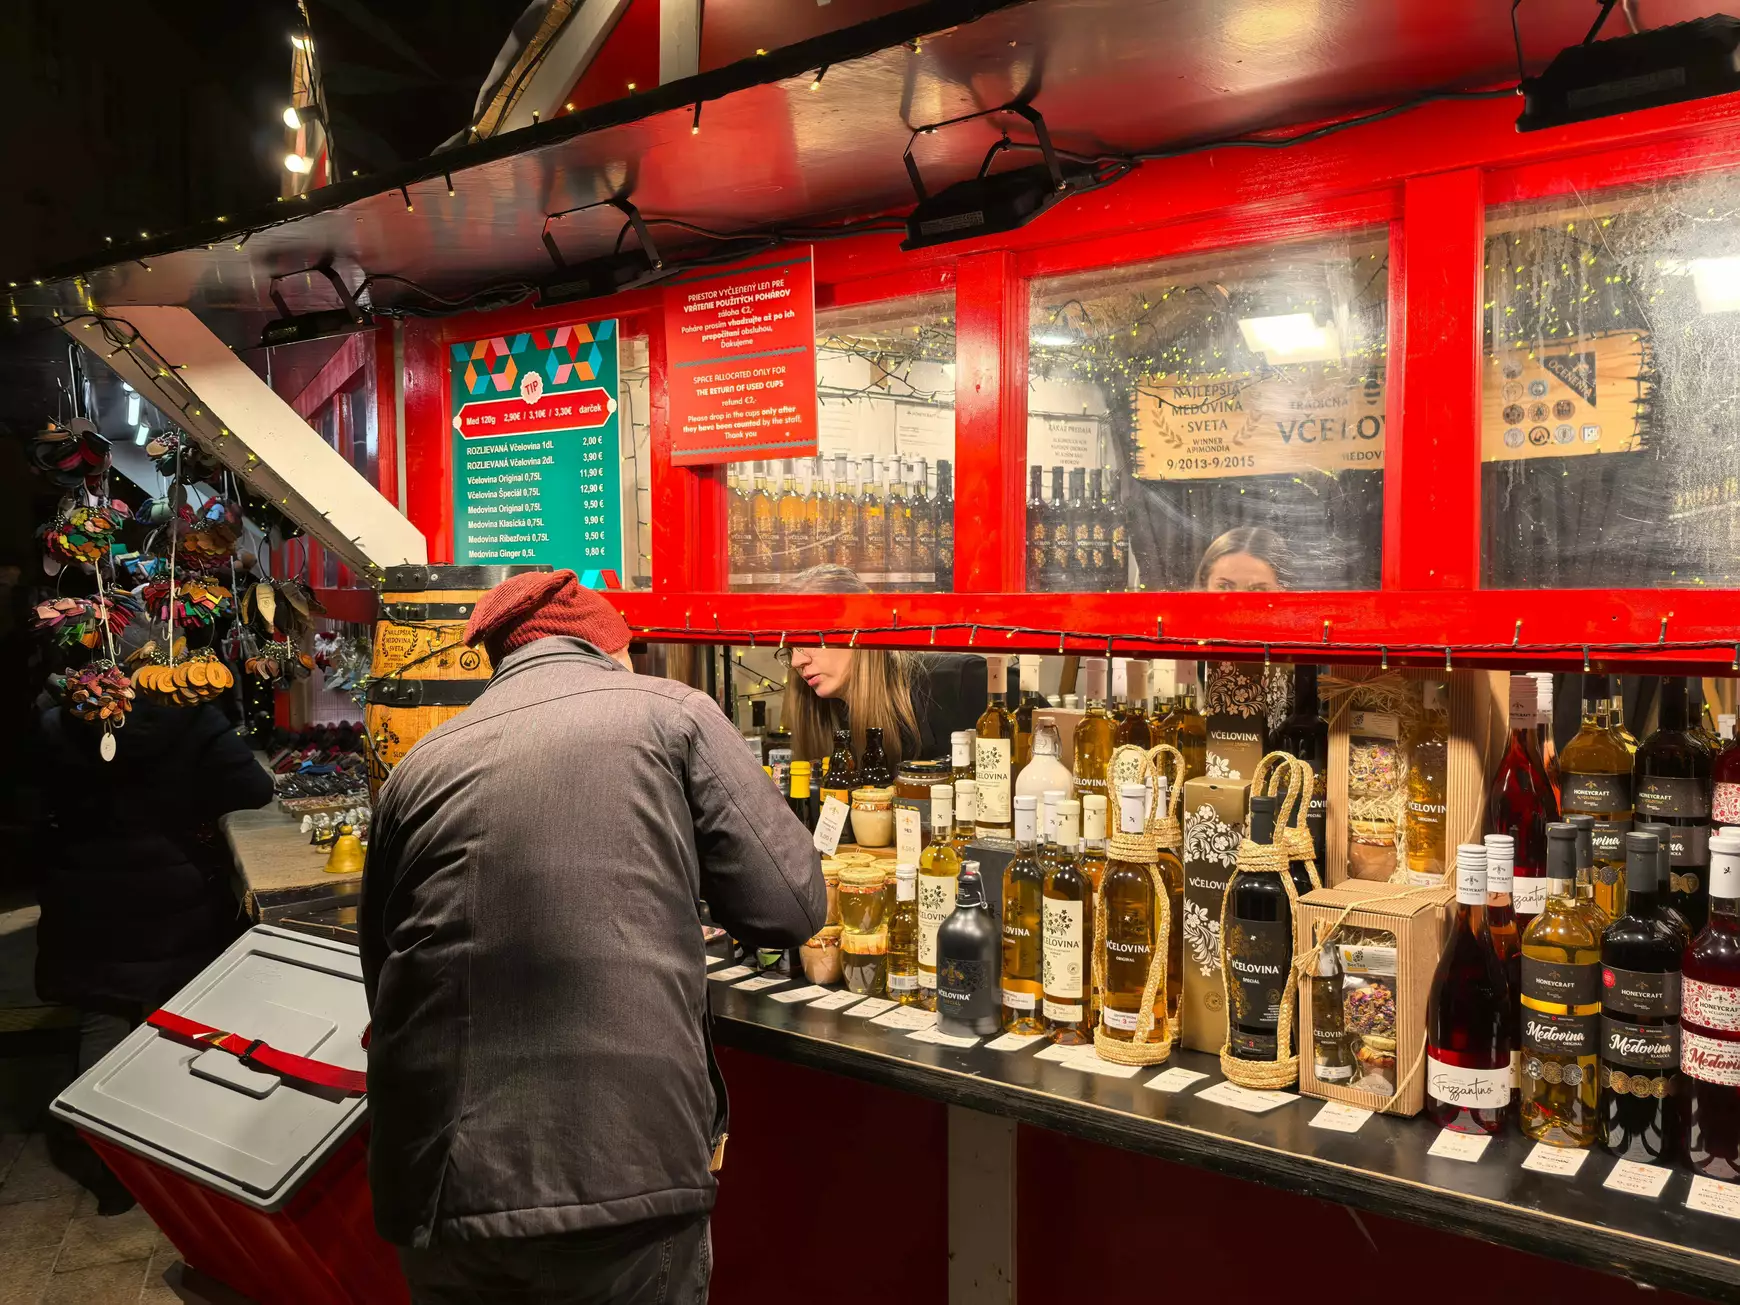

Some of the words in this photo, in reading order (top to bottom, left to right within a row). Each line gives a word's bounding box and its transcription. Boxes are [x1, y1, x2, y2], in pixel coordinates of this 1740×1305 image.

[688, 290, 718, 302] PRIESTOR
[758, 281, 770, 290] LEN
[772, 279, 784, 288] PRE
[755, 289, 791, 301] POHÁROV
[718, 309, 739, 318] záloha
[681, 325, 703, 334] Poháre
[728, 316, 762, 327] vhadzujte
[774, 313, 782, 321] po
[784, 310, 795, 318] ich
[693, 375, 713, 384] SPACE
[714, 370, 751, 381] ALLOCATED
[752, 368, 770, 377] ONLY
[772, 366, 786, 375] FOR
[524, 380, 539, 395] TIP
[710, 386, 735, 395] RETURN
[746, 382, 764, 391] USED
[766, 380, 784, 388] CUPS
[722, 398, 742, 407] refund
[1172, 400, 1244, 416] MEDOVINA
[466, 416, 479, 425] Med
[481, 416, 496, 426] 120g
[579, 403, 601, 414] darček
[710, 413, 724, 422] drop
[733, 410, 744, 418] the
[745, 409, 760, 418] cups
[762, 407, 777, 416] only
[683, 425, 697, 433] they
[698, 423, 714, 431] have
[734, 419, 761, 428] counted
[762, 418, 770, 427] by
[1187, 420, 1228, 433] SVETA
[724, 431, 743, 439] Thank
[1192, 437, 1223, 446] WINNER
[467, 442, 508, 455] ROZLIEVANÁ
[510, 442, 540, 452] Včelovina
[542, 441, 554, 449] 1dL
[582, 436, 596, 446] 2,00
[1187, 445, 1230, 454] APIMONDIA
[467, 459, 509, 470] ROZLIEVANÁ
[510, 458, 541, 468] Včelovina
[542, 457, 555, 465] 2dL
[583, 453, 597, 462] 3,90
[1167, 456, 1255, 470] 9/2013-9/2015
[467, 476, 497, 485] Včelovina
[498, 474, 523, 484] Original
[524, 472, 542, 482] 0,75L
[579, 469, 597, 478] 11,90
[468, 490, 497, 499] Včelovina
[499, 487, 522, 499] Špeciál
[523, 488, 540, 497] 0,75L
[580, 485, 597, 494] 12,90
[468, 505, 497, 514] Medovina
[499, 504, 523, 515] Original
[524, 503, 542, 512] 0,75L
[468, 520, 497, 529] Medovina
[499, 519, 525, 527] Klasická
[527, 518, 544, 527] 0,75L
[469, 535, 498, 544] Medovina
[532, 534, 549, 542] 0,75L
[469, 550, 498, 558] Medovina
[500, 549, 521, 559] Ginger
[522, 549, 535, 557] 0,5L
[1211, 730, 1259, 741] VČELOVINA
[1189, 878, 1228, 890] VČELOVI
[1232, 959, 1279, 974] VČELOVINA
[1536, 978, 1575, 988] HONEYCRAFT
[1622, 989, 1662, 998] HONEYCRAFT
[1526, 1021, 1585, 1042] Medovina
[1609, 1034, 1672, 1056] Medovina
[1688, 1047, 1740, 1070] Medovi
